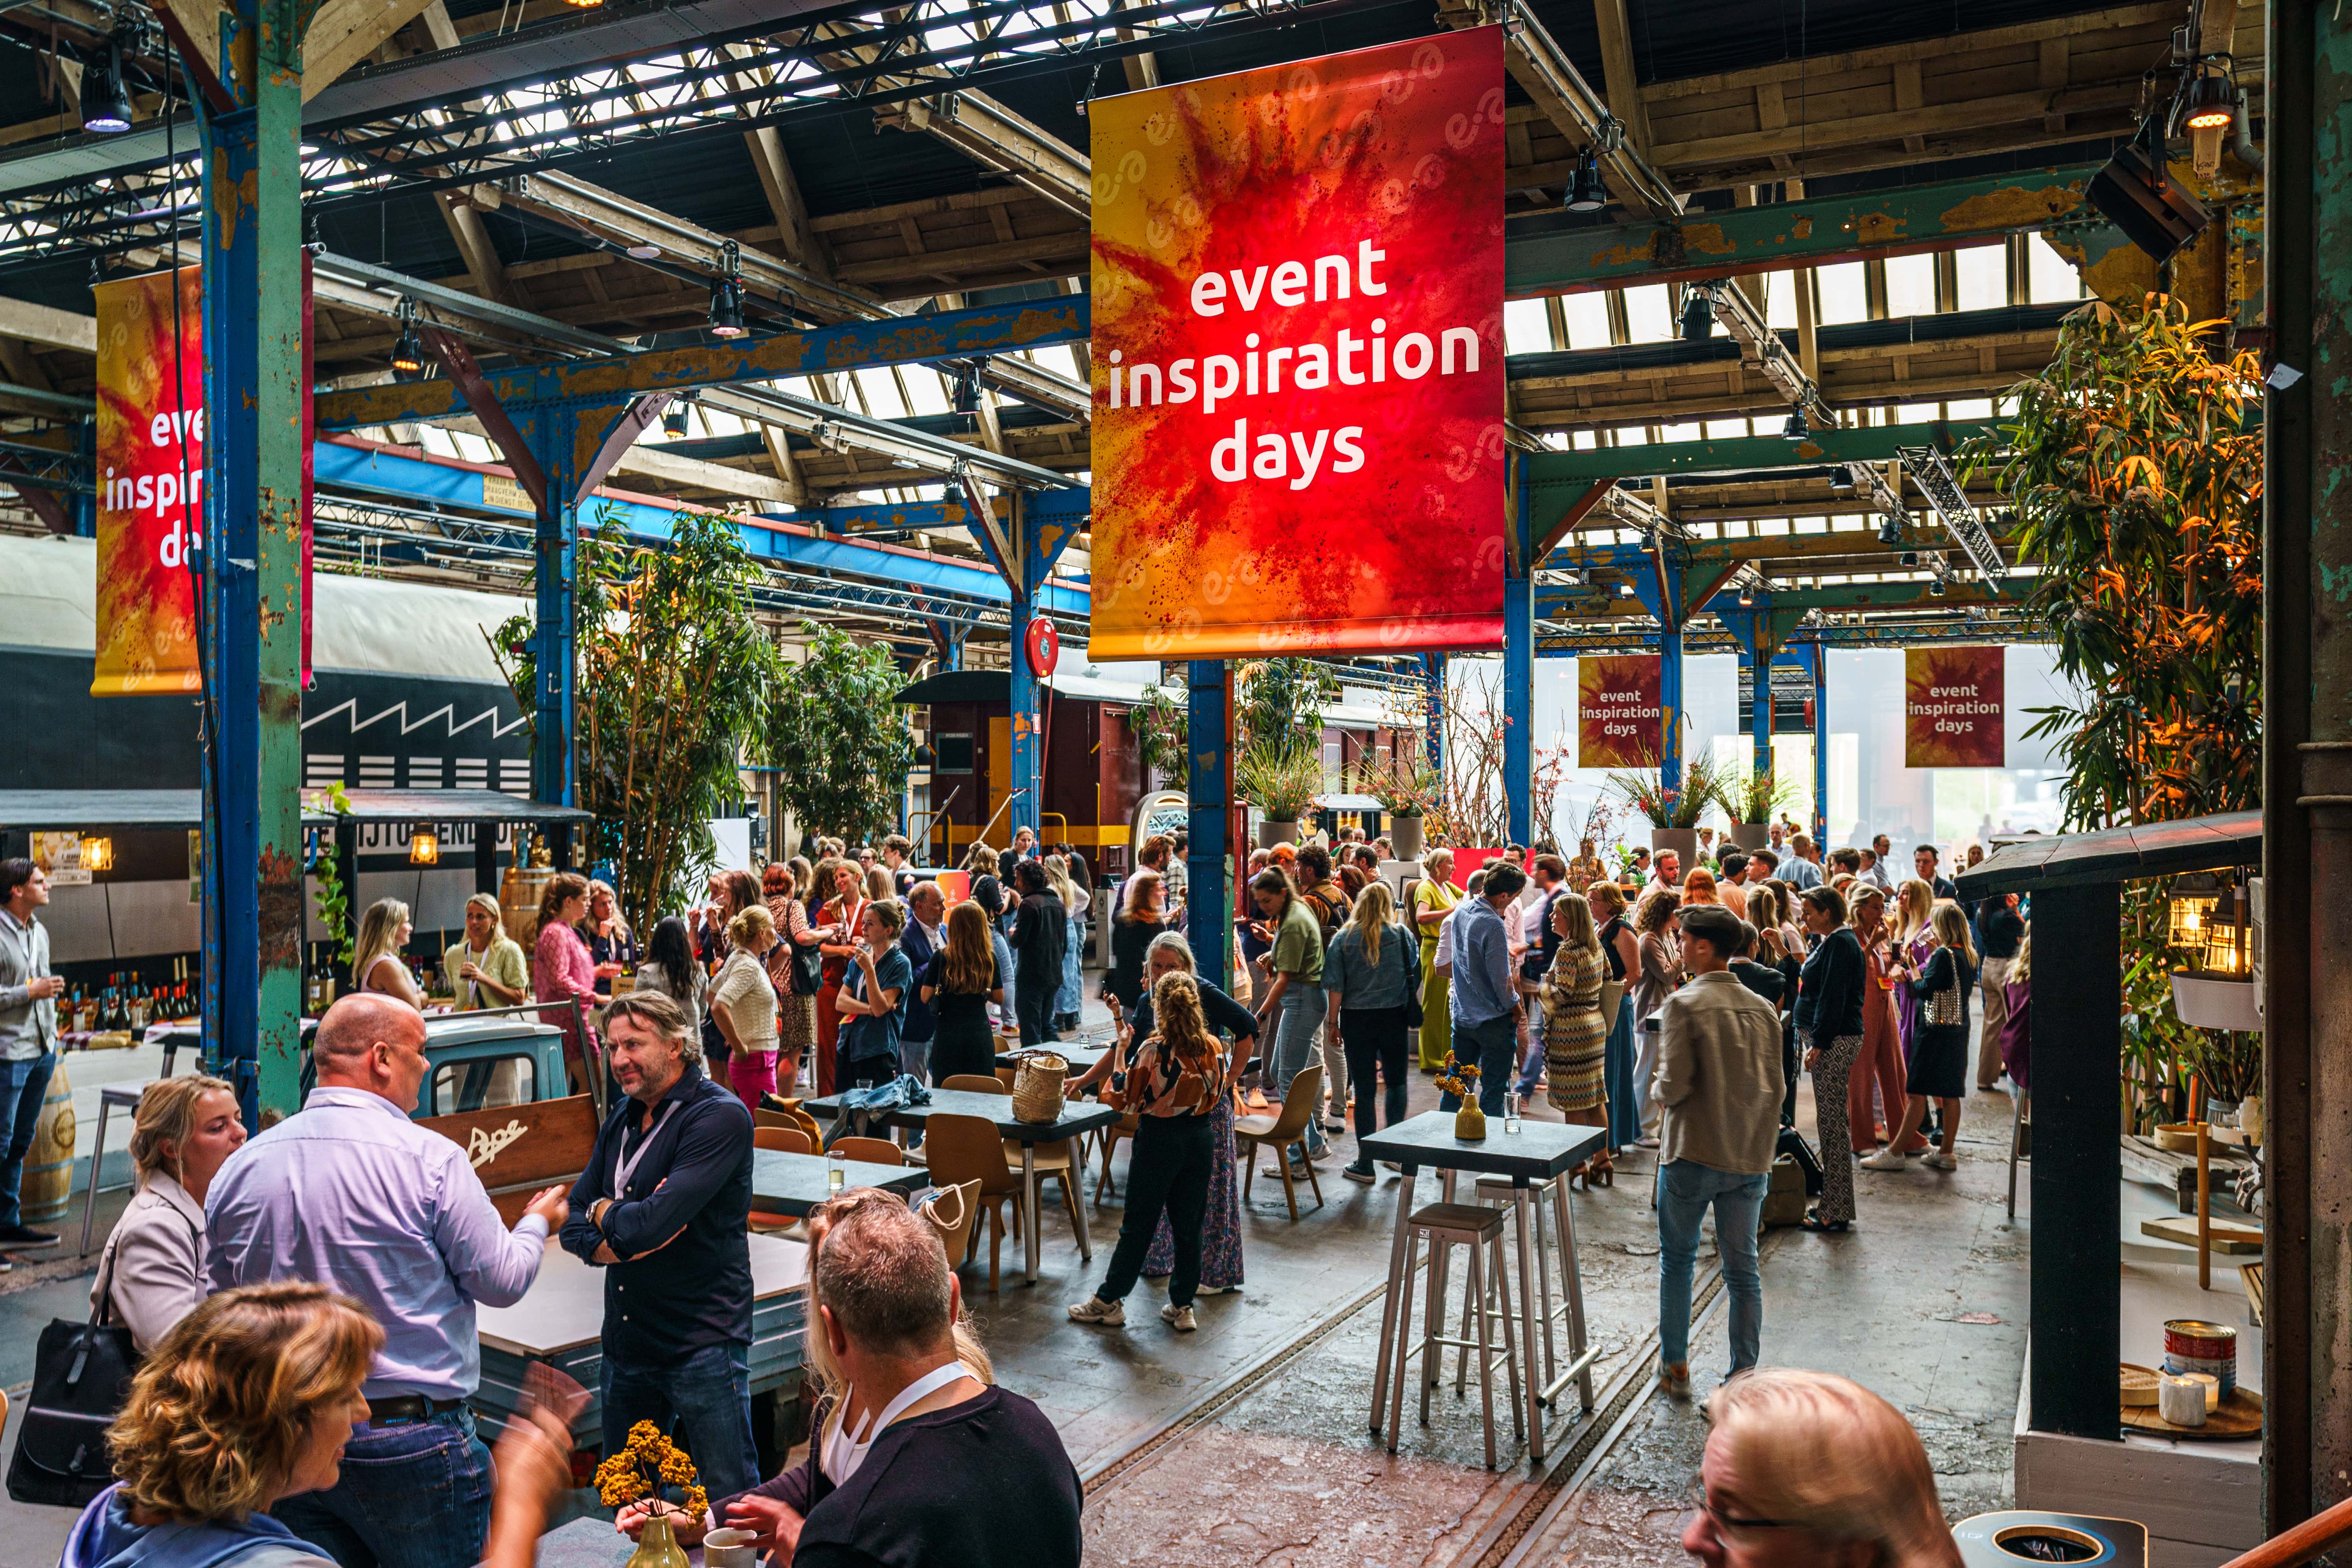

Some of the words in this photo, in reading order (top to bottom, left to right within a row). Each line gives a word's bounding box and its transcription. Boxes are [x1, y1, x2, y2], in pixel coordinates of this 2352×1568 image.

[1191, 238, 1387, 317] event
[1110, 318, 1479, 414] inspiration
[151, 407, 203, 446] eve
[1210, 418, 1365, 490] days
[107, 458, 203, 518] inspir
[1600, 690, 1641, 702] event
[1930, 685, 1978, 697] event
[1582, 705, 1660, 721] inspiration
[1909, 700, 1999, 717] inspiration
[1604, 722, 1637, 737] days
[1935, 718, 1973, 734] days
